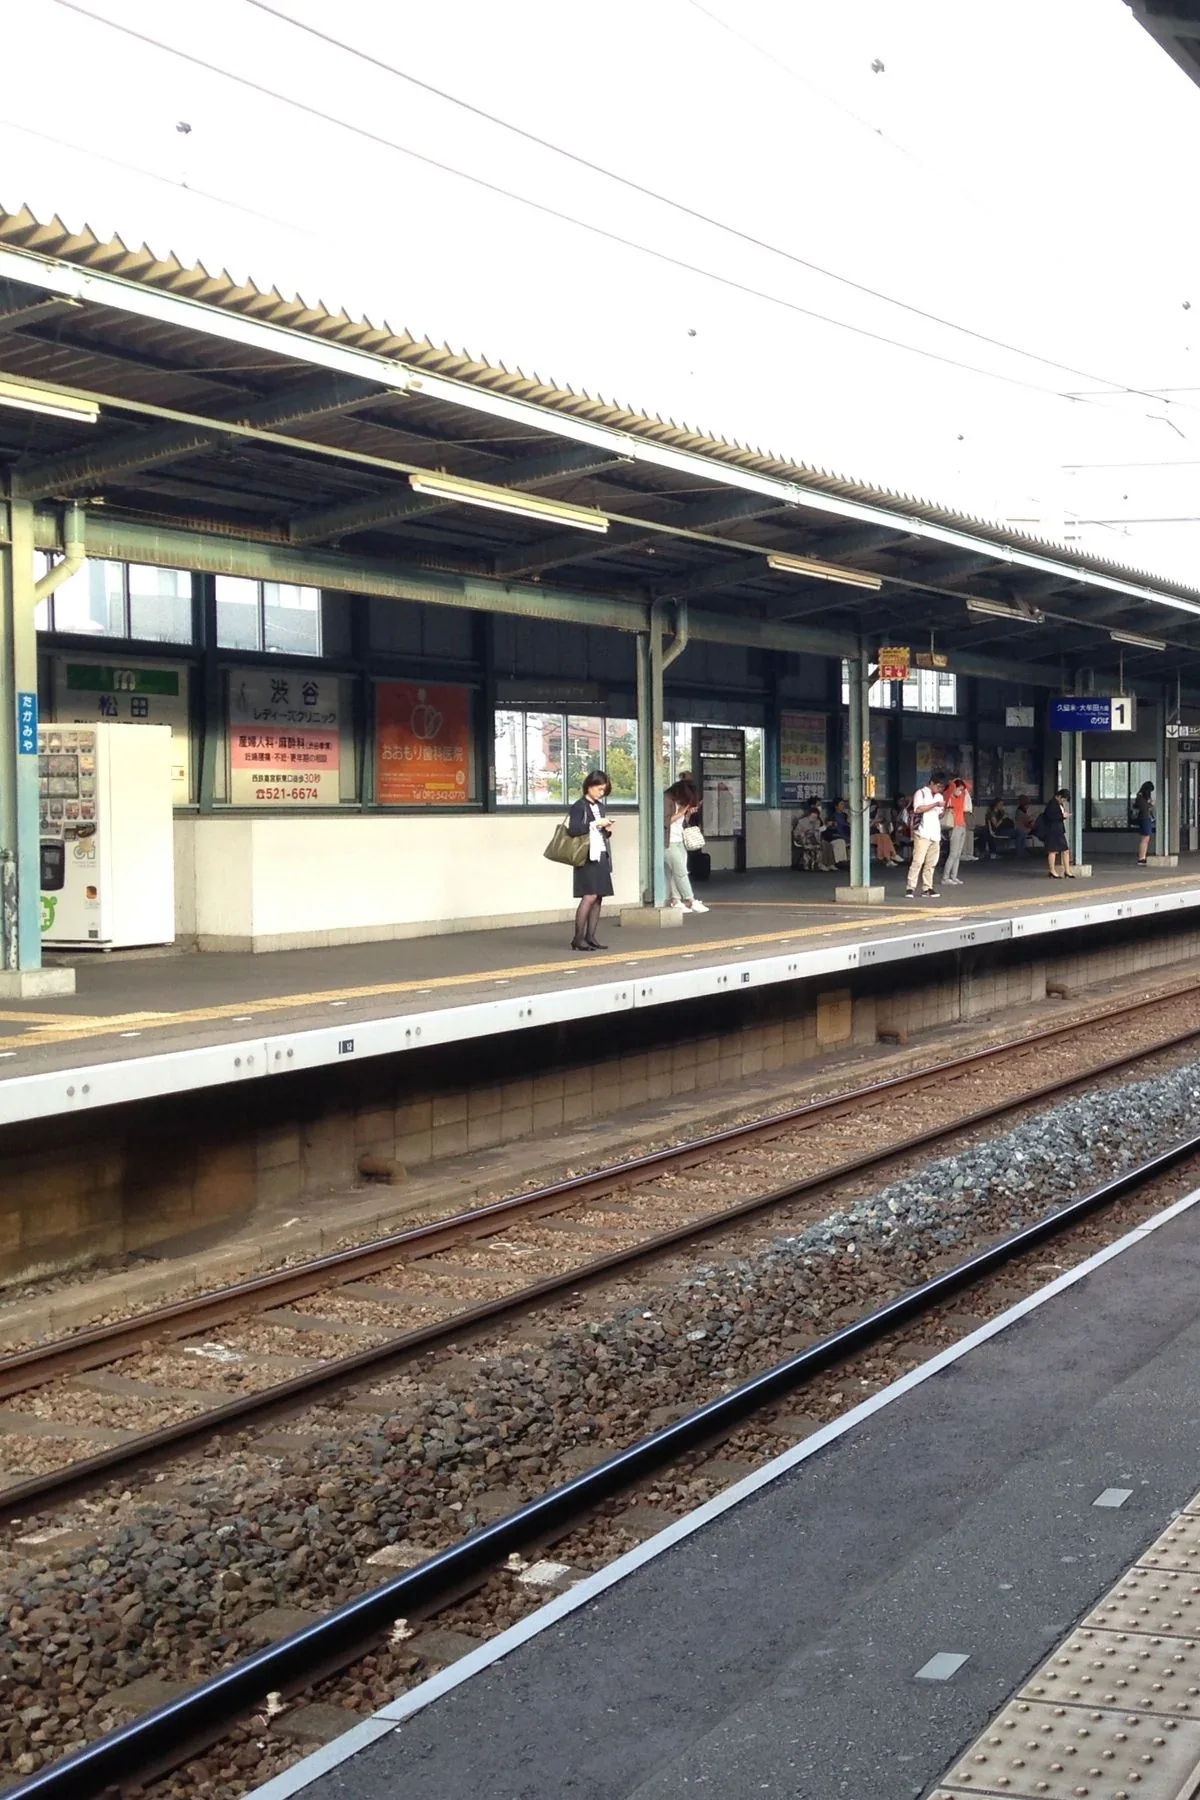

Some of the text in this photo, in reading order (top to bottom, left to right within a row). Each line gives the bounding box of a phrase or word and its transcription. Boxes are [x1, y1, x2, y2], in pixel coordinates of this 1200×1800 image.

[271, 679, 319, 705] 渋谷
[98, 695, 149, 717] 松田
[253, 708, 337, 724] レディースクリニック
[1115, 704, 1124, 724] 1
[22, 696, 34, 751] たかみや
[1090, 717, 1110, 725] のりば
[266, 788, 318, 800] 521-6674
